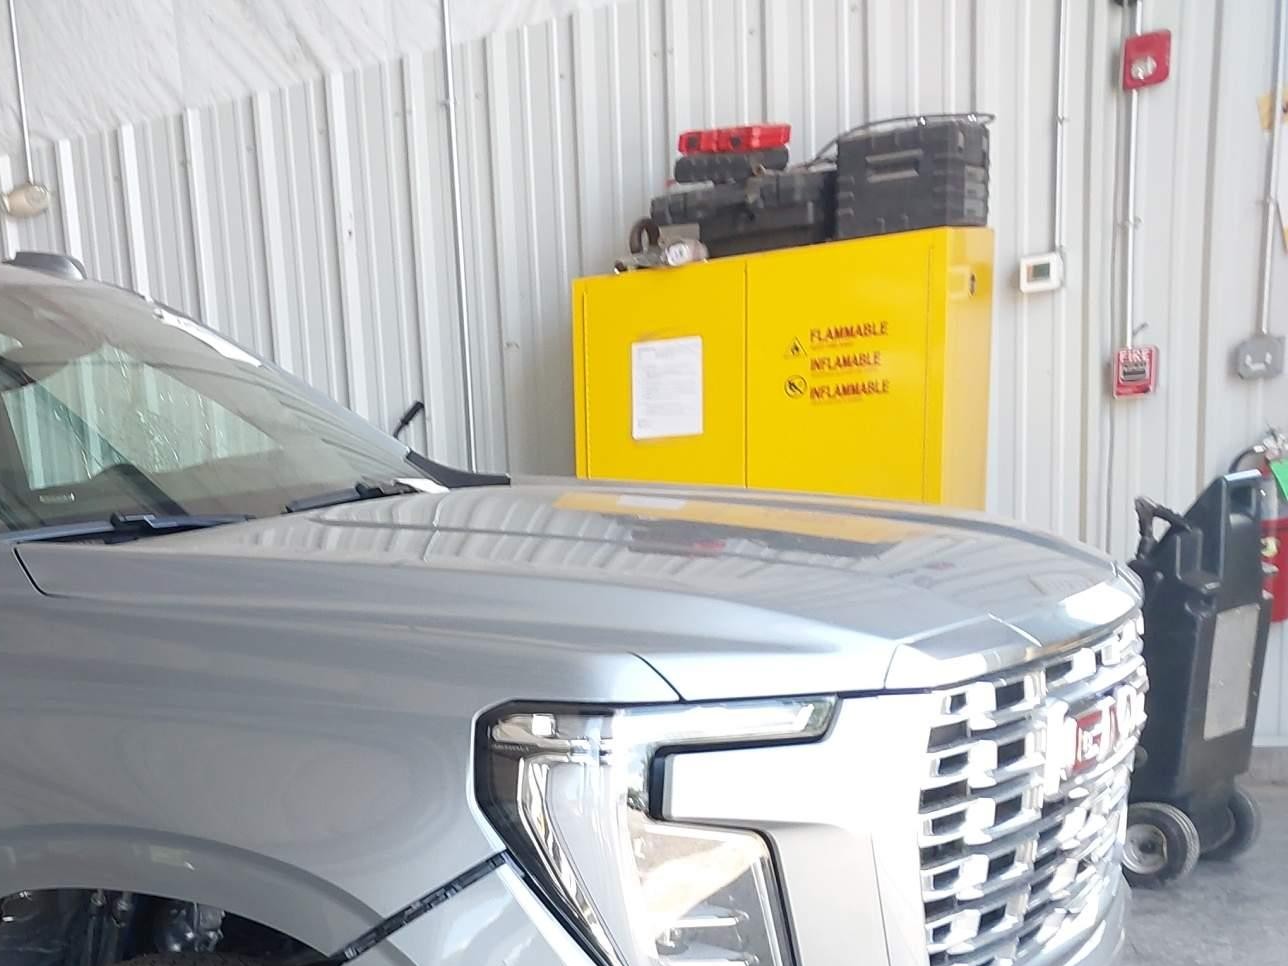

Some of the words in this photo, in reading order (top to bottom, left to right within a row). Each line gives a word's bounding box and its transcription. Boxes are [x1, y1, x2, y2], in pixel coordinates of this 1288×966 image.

[809, 319, 888, 342] FLAMMABLE
[809, 351, 880, 371] INFLAMABLE
[809, 378, 889, 400] INFLAMMABLE
